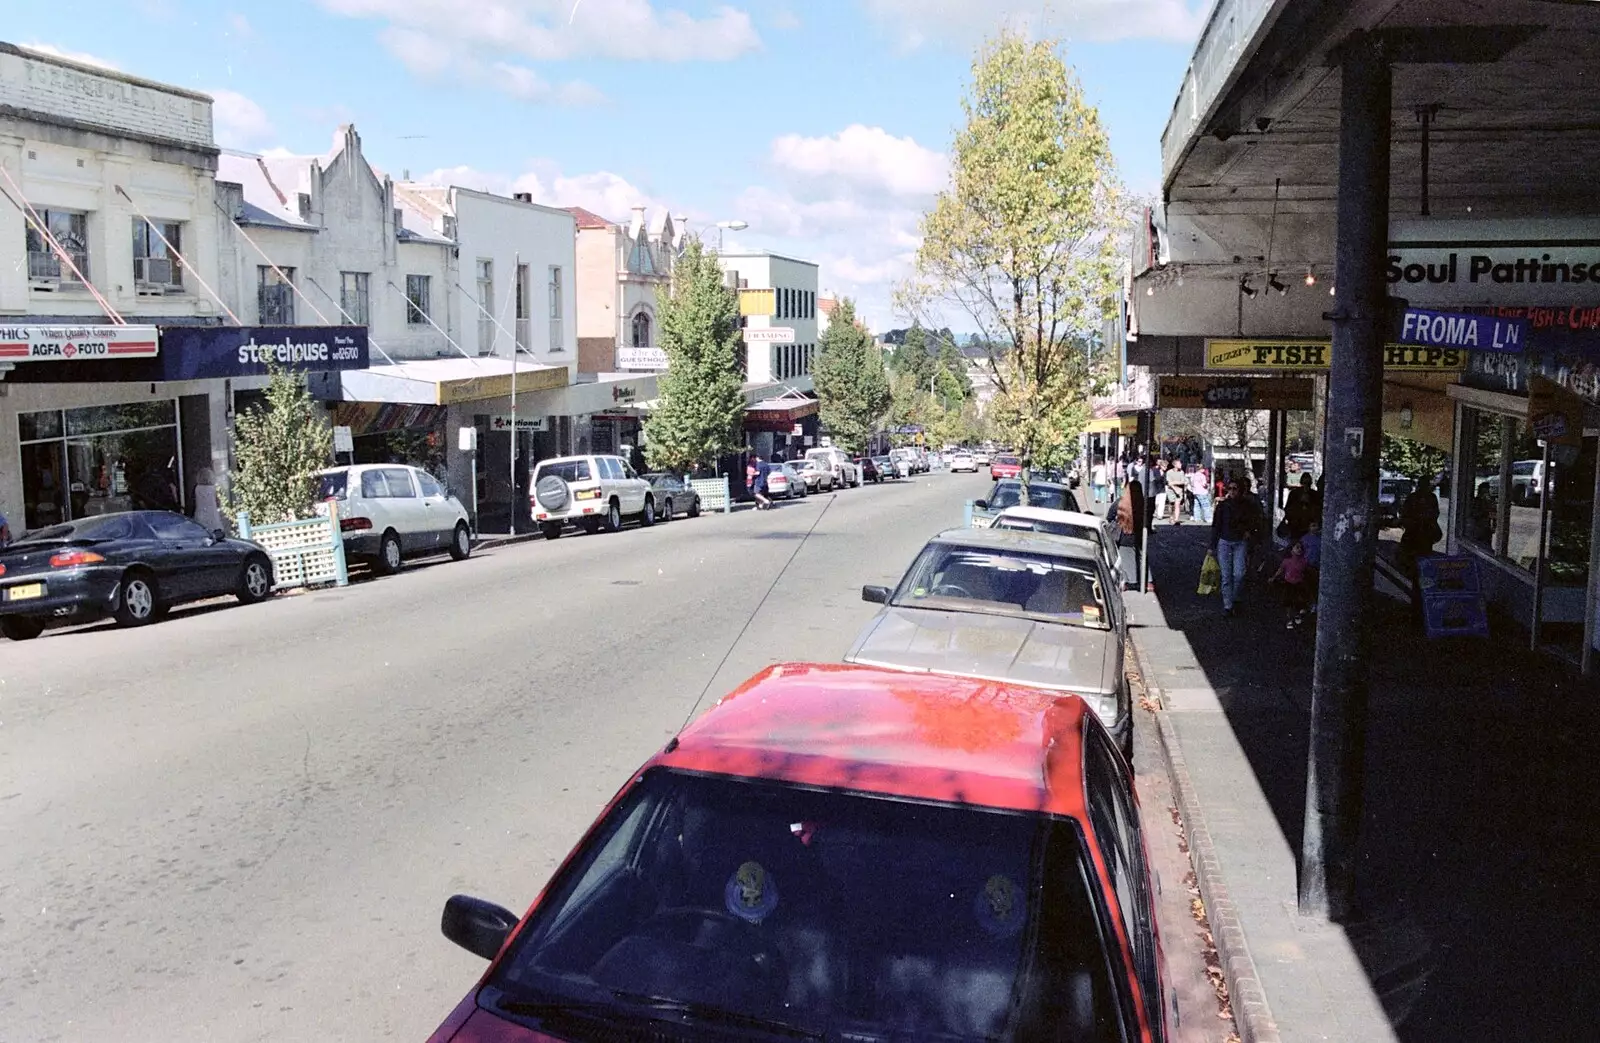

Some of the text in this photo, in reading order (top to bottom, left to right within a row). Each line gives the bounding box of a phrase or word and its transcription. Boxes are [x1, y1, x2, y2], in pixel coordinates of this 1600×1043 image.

[0, 328, 30, 340] HICS
[1401, 312, 1479, 347] FROMA
[1491, 320, 1520, 349] LN
[32, 343, 61, 356] AGFA
[77, 343, 106, 355] FOTO
[238, 337, 328, 363] storehouse
[1252, 345, 1325, 364] FISH
[1384, 347, 1459, 365] HIPS
